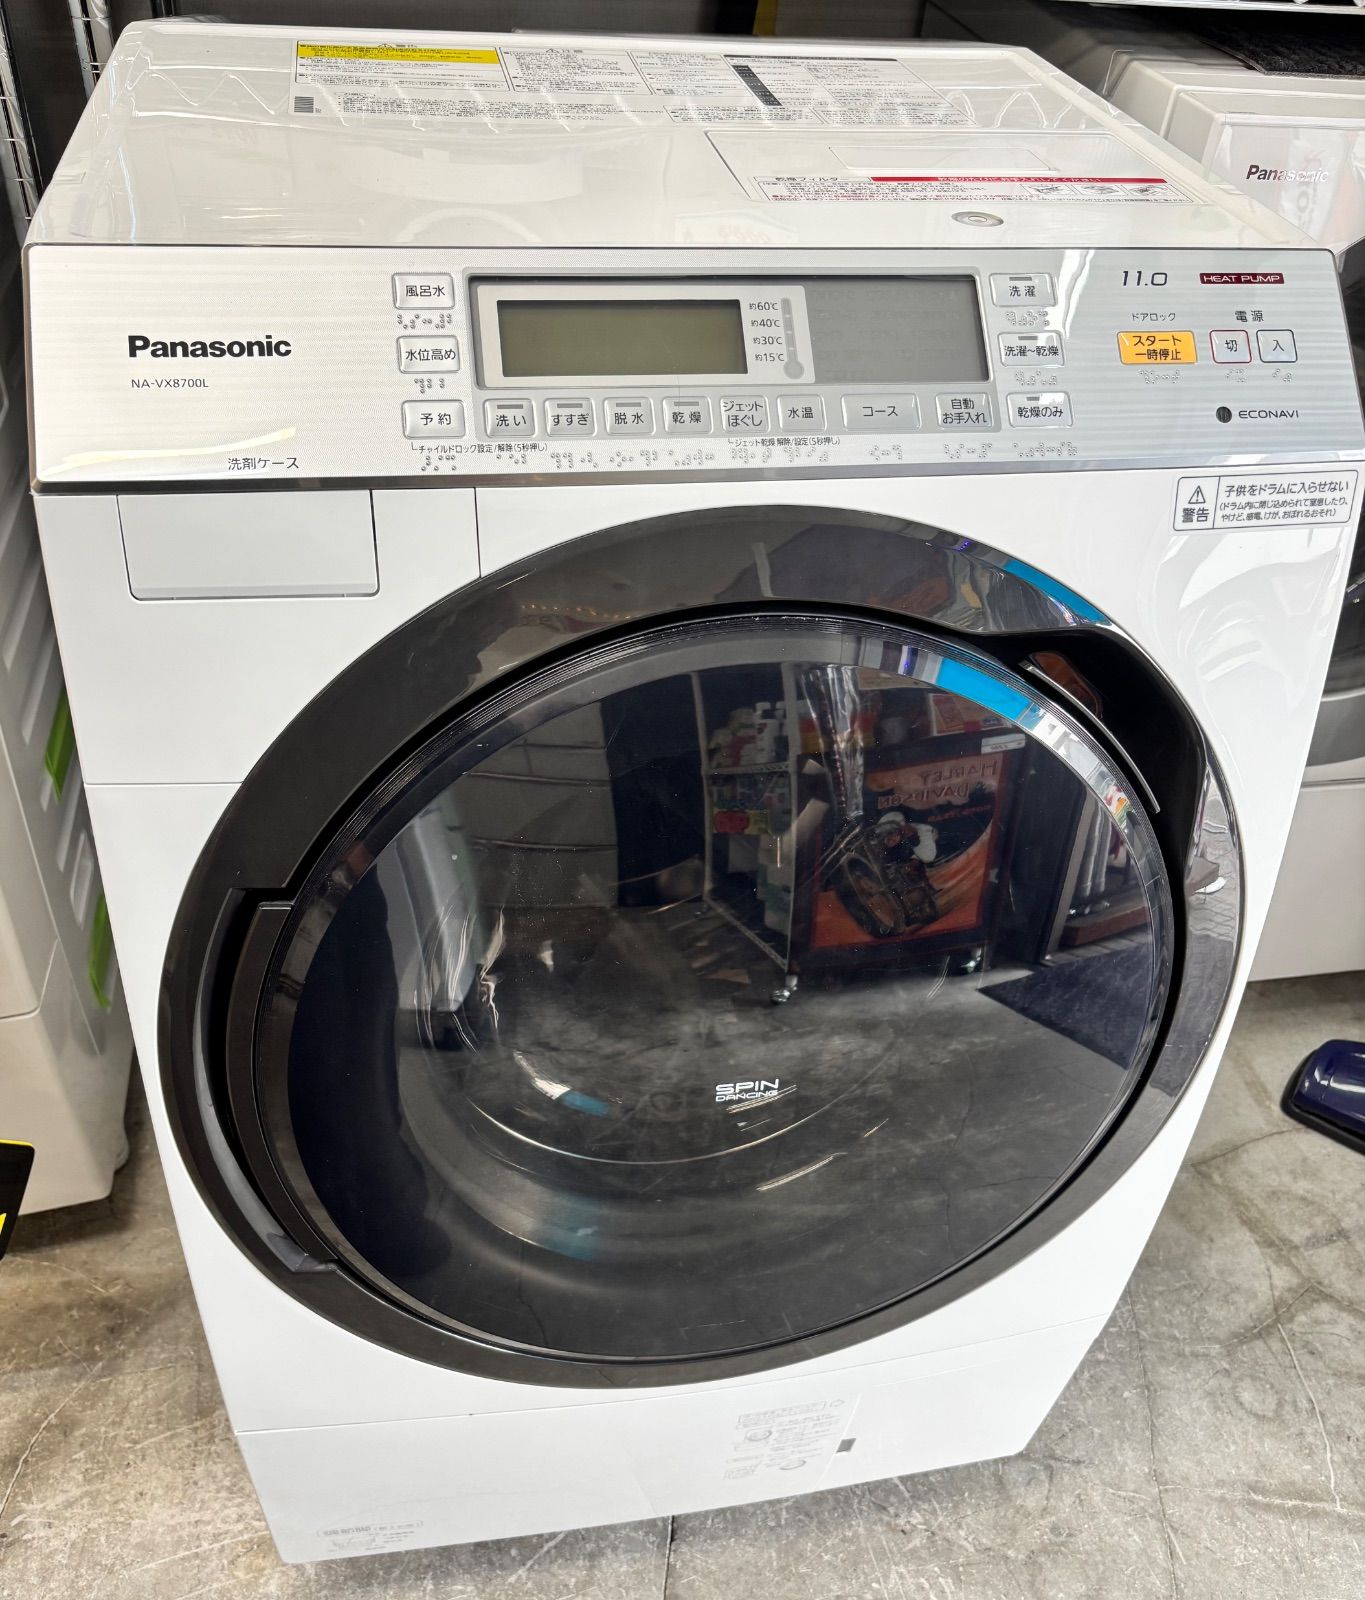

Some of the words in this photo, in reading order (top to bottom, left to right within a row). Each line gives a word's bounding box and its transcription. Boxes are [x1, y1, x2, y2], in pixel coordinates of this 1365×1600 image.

[1246, 165, 1329, 182] Panasonic
[1122, 270, 1168, 287] 11.0
[1203, 274, 1241, 283] HEAT
[1243, 274, 1281, 283] PUMP
[405, 285, 446, 298] 風呂水
[1009, 285, 1036, 298] 洗濯
[1132, 312, 1176, 322] ドアロック
[1235, 310, 1264, 323] 電源
[128, 335, 292, 358] Panasonic
[1133, 335, 1182, 347] スタート
[1225, 339, 1238, 352] 切
[1272, 339, 1285, 352] 入
[405, 349, 456, 361] 水位高め
[1135, 348, 1182, 361] 一時停止
[131, 379, 209, 389] NA-VX8700L
[723, 400, 764, 412] ジェット
[951, 398, 975, 410] 自動
[672, 411, 702, 424] 乾燥
[787, 406, 814, 419] 水温
[863, 405, 899, 417] コース
[1017, 406, 1064, 418] 乾燥のみ
[1238, 409, 1299, 419] ECONAVI
[420, 413, 452, 426] 予約
[496, 415, 527, 427] 洗い
[551, 413, 590, 426] すすぎ
[614, 412, 645, 425] 脱水
[728, 414, 763, 427] ほぐし
[942, 411, 988, 425] お手入れ
[228, 457, 300, 471] 洗剤ケース
[1224, 481, 1349, 498] 子供をドラムに入らせない
[1182, 507, 1210, 523] 警告
[715, 1078, 780, 1096] SPIN
[715, 1089, 779, 1102] DANCING
